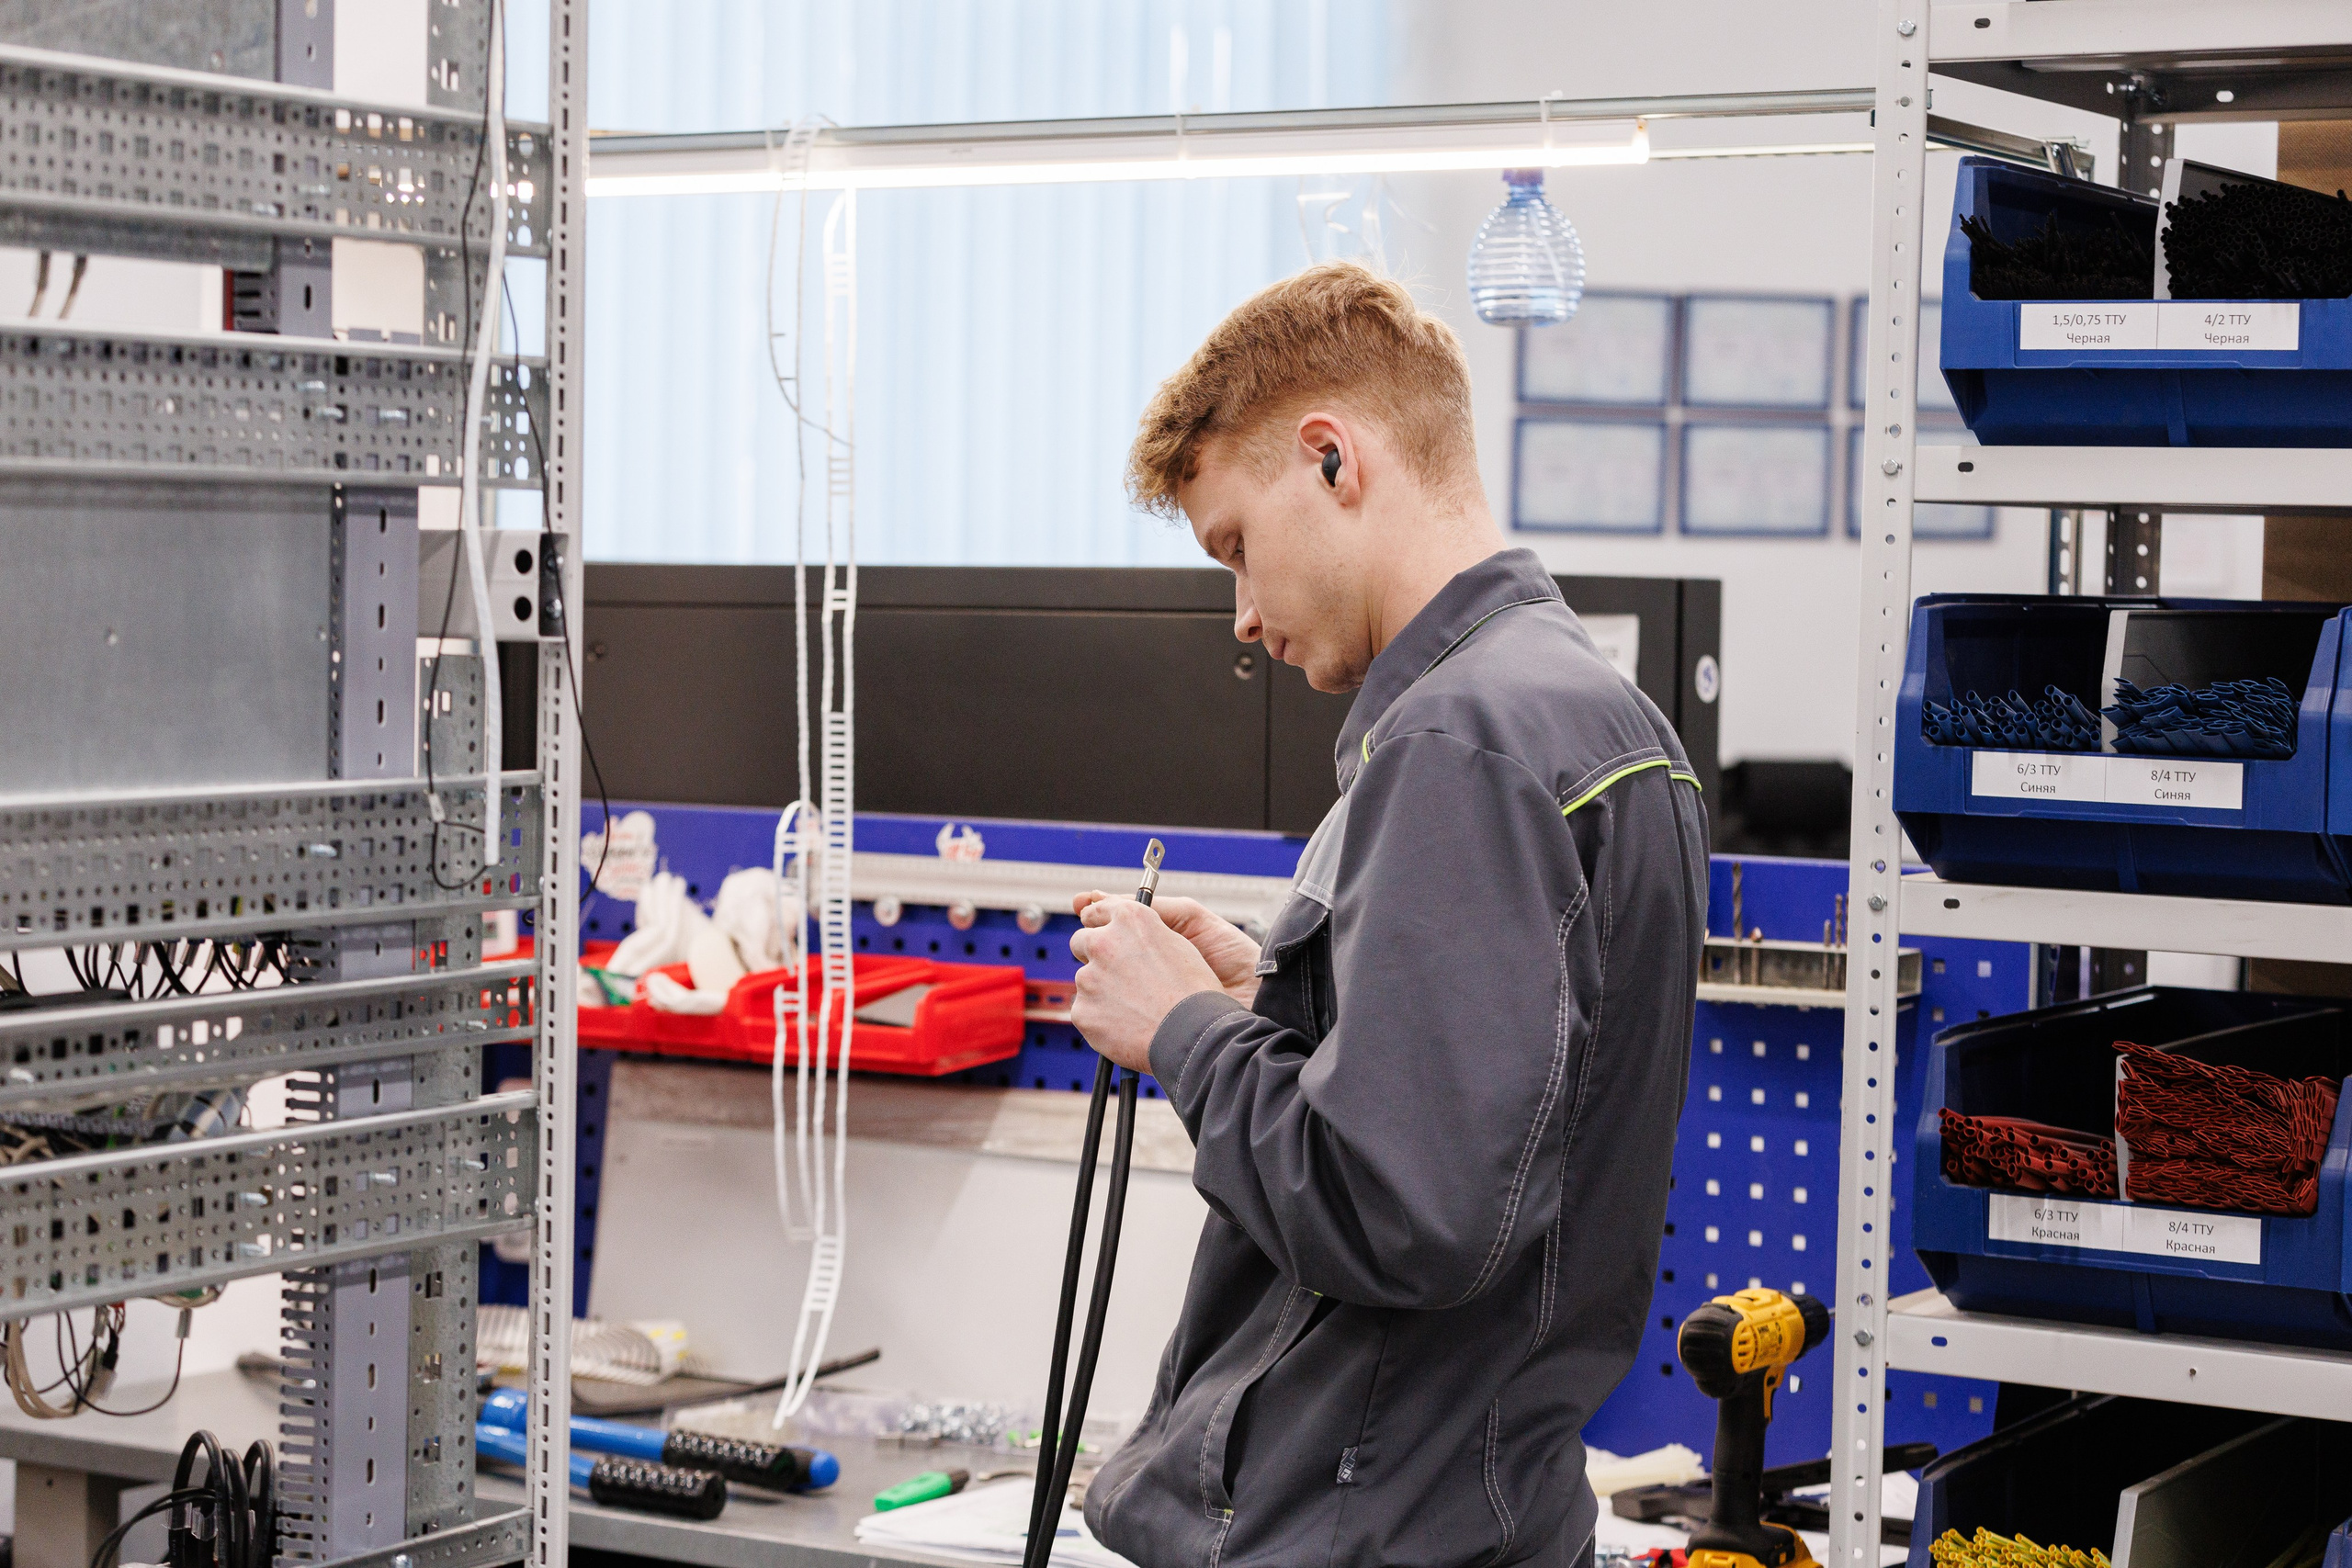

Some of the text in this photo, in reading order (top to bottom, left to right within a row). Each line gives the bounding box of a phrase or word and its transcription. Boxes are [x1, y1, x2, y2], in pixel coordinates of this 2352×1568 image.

[2052, 314, 2126, 327] 1,5/0,75 ТТУ
[2204, 314, 2251, 326] 4/2 ТТУ
[2067, 333, 2110, 345] Черная
[2205, 333, 2249, 345] Черная
[2017, 763, 2061, 776] 6/3 ТТУ
[2151, 770, 2196, 783] 8/4 ТТУ
[2020, 783, 2056, 794] Синяя
[2154, 789, 2190, 800] Синяя
[2034, 1208, 2078, 1223] 6/3 ТТУ
[2031, 1226, 2080, 1241] Красная
[2169, 1221, 2214, 1235] 8/4 ТТУ
[2166, 1239, 2215, 1255] Красная
